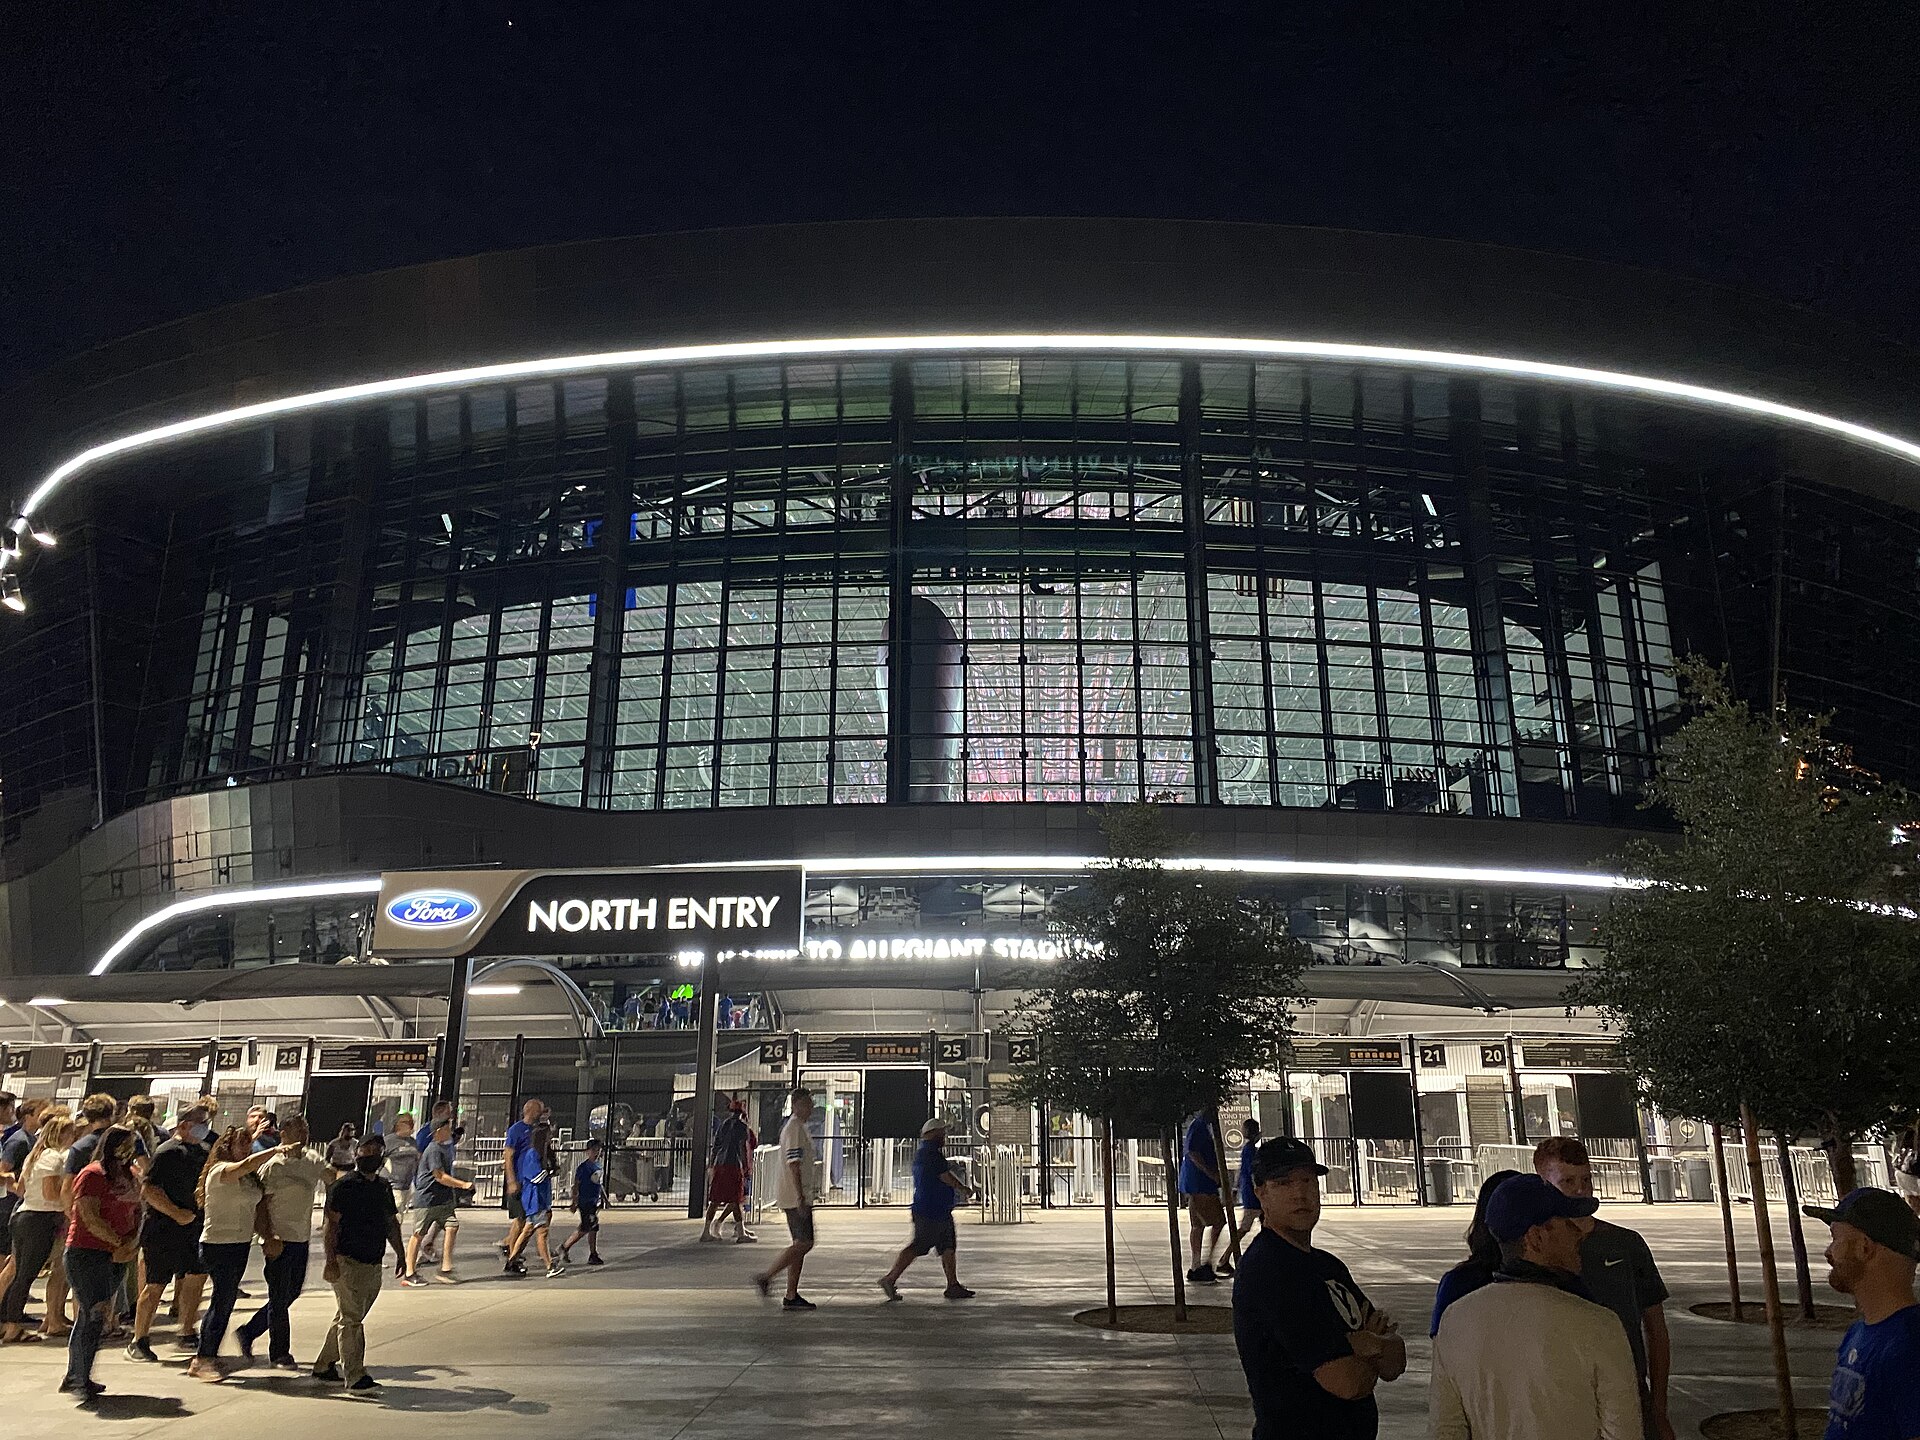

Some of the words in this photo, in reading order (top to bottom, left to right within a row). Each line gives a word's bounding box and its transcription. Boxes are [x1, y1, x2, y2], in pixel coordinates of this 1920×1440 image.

[404, 897, 458, 921] Ford
[527, 898, 658, 933] NORTH
[667, 896, 781, 930] ENTRY
[806, 939, 842, 959] TO
[279, 1052, 297, 1064] 28
[764, 1045, 783, 1058] 26
[942, 1045, 962, 1058] 25
[1424, 1049, 1442, 1062] 21
[1485, 1049, 1503, 1062] 20
[8, 1055, 24, 1068] 31
[66, 1055, 83, 1068] 30
[219, 1052, 238, 1065] 29
